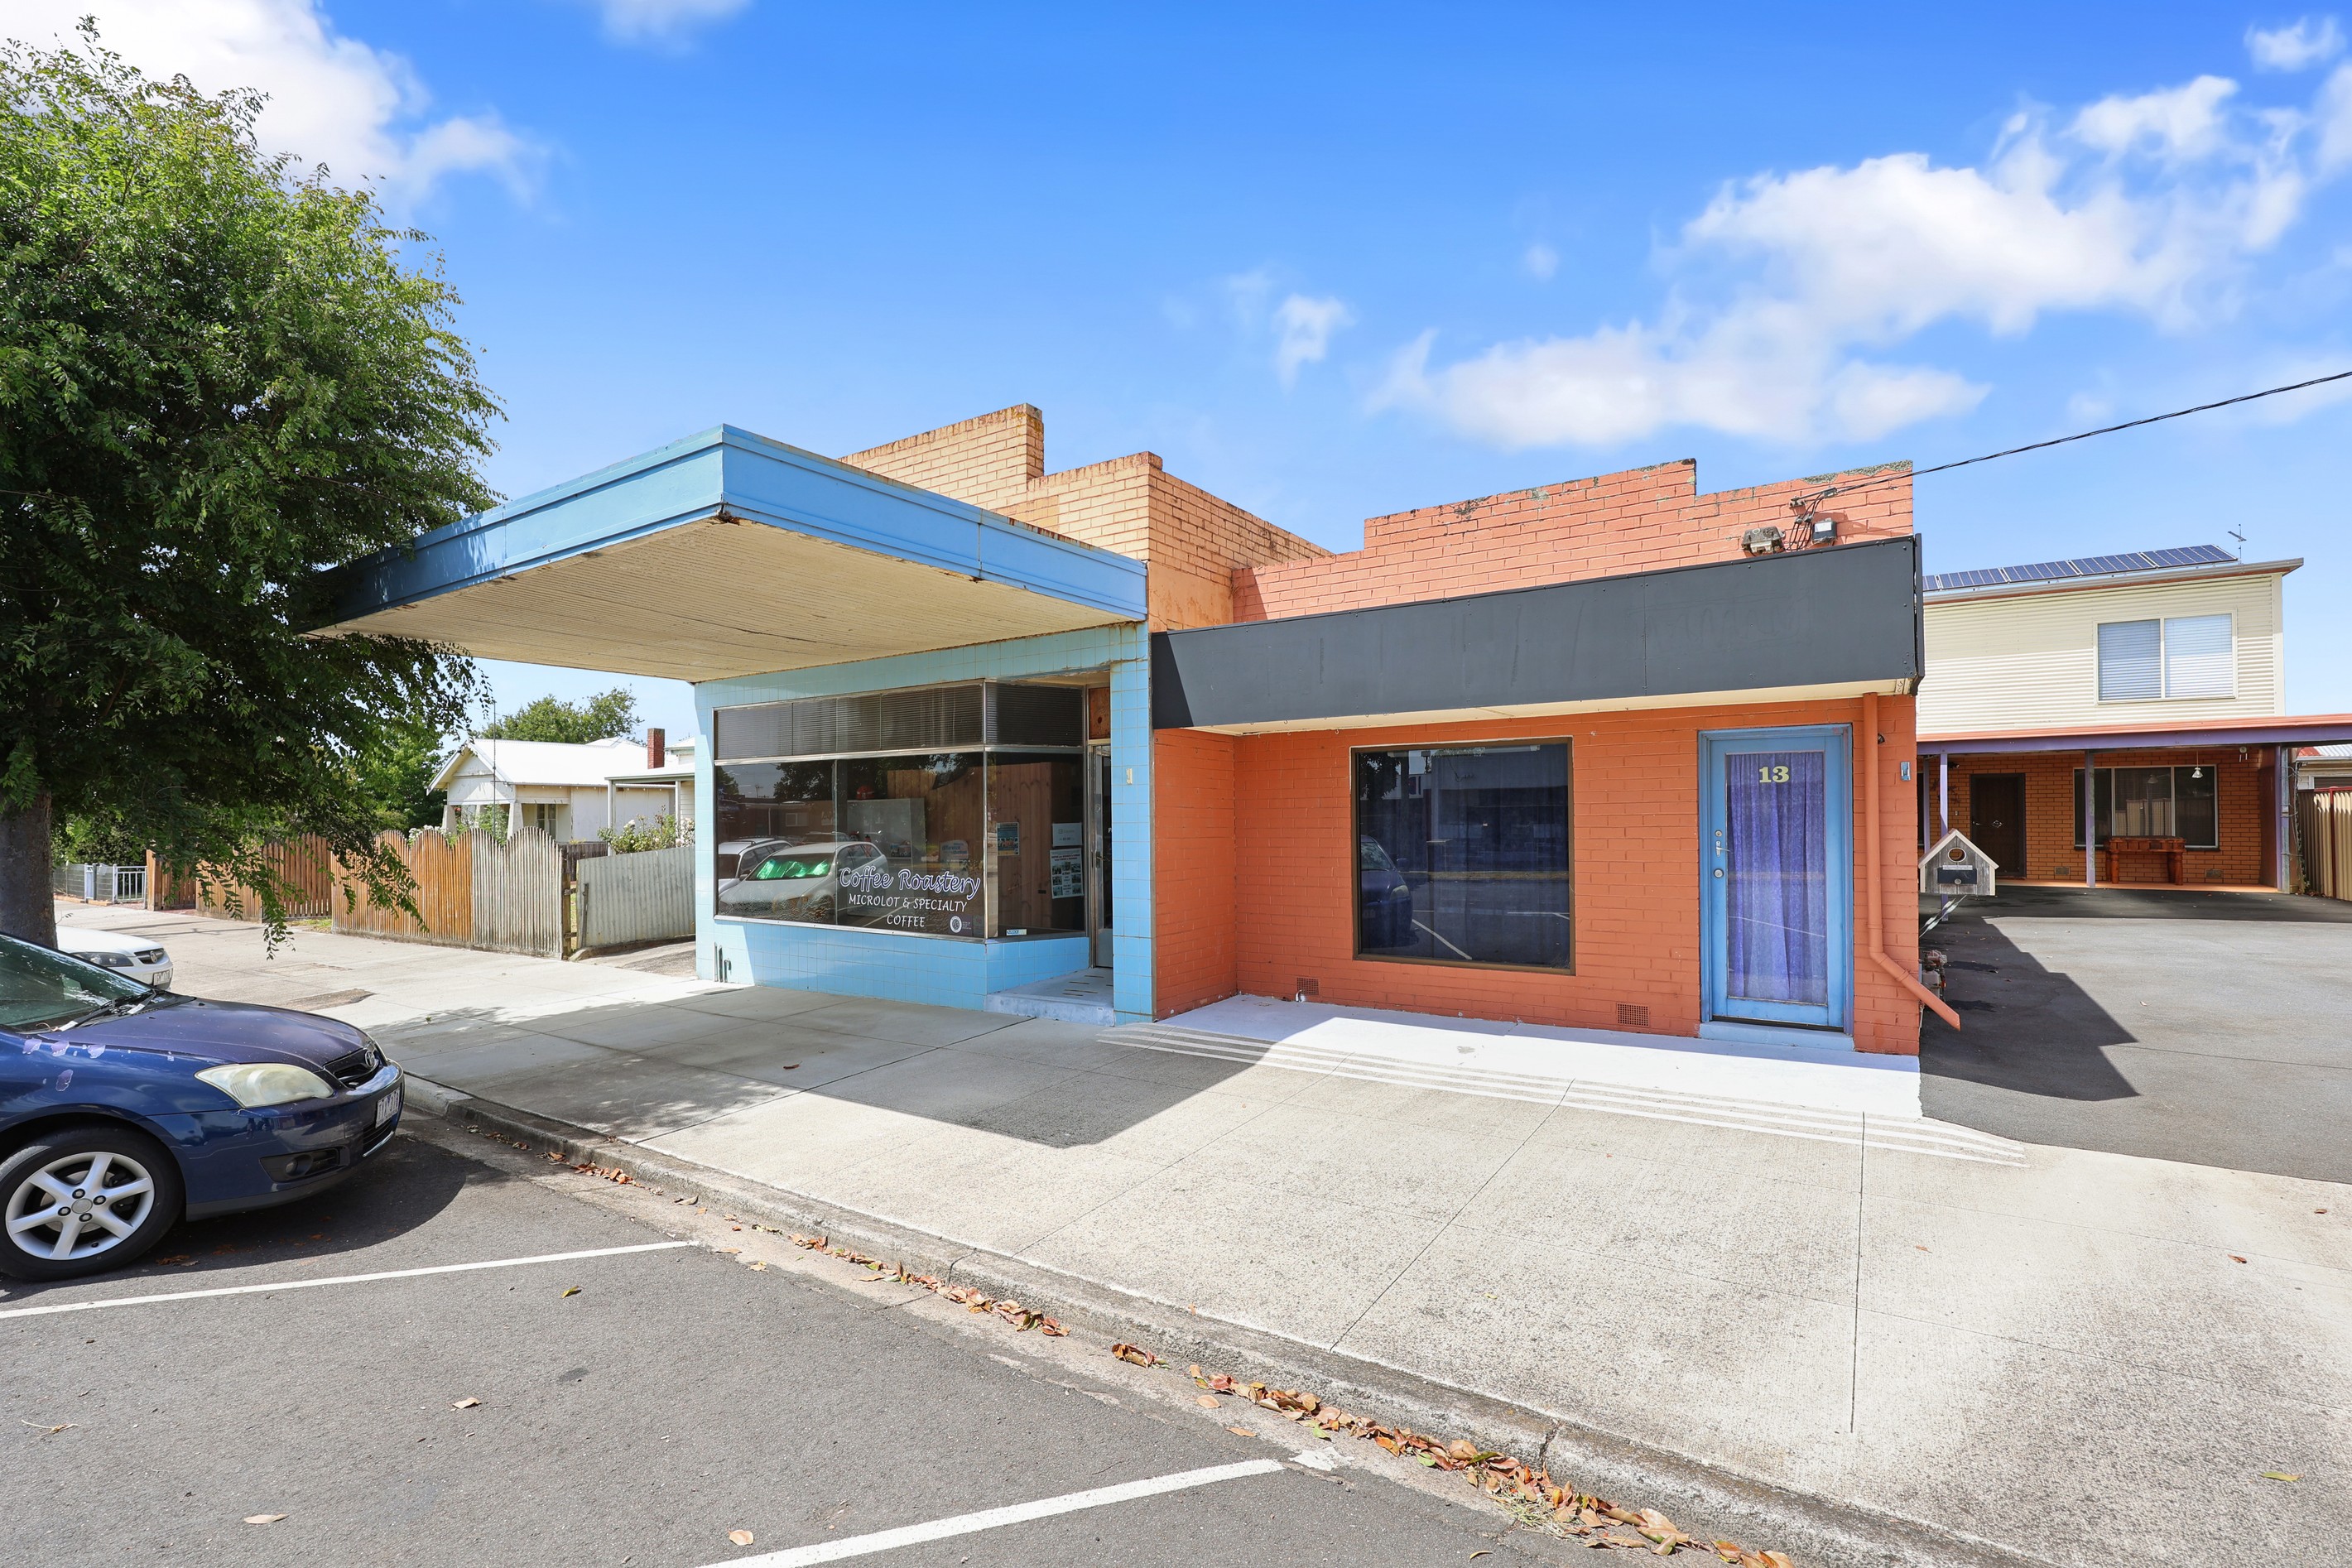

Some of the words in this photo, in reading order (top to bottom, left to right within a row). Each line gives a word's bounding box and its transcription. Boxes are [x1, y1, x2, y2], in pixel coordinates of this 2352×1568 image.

[1759, 766, 1789, 783] 13
[839, 865, 894, 892] Coffee
[898, 869, 980, 900] Roastery
[849, 893, 899, 907] MICROLOT
[902, 898, 911, 909] &
[913, 898, 967, 912] SPECIALTY
[887, 914, 925, 927] COFFEE
